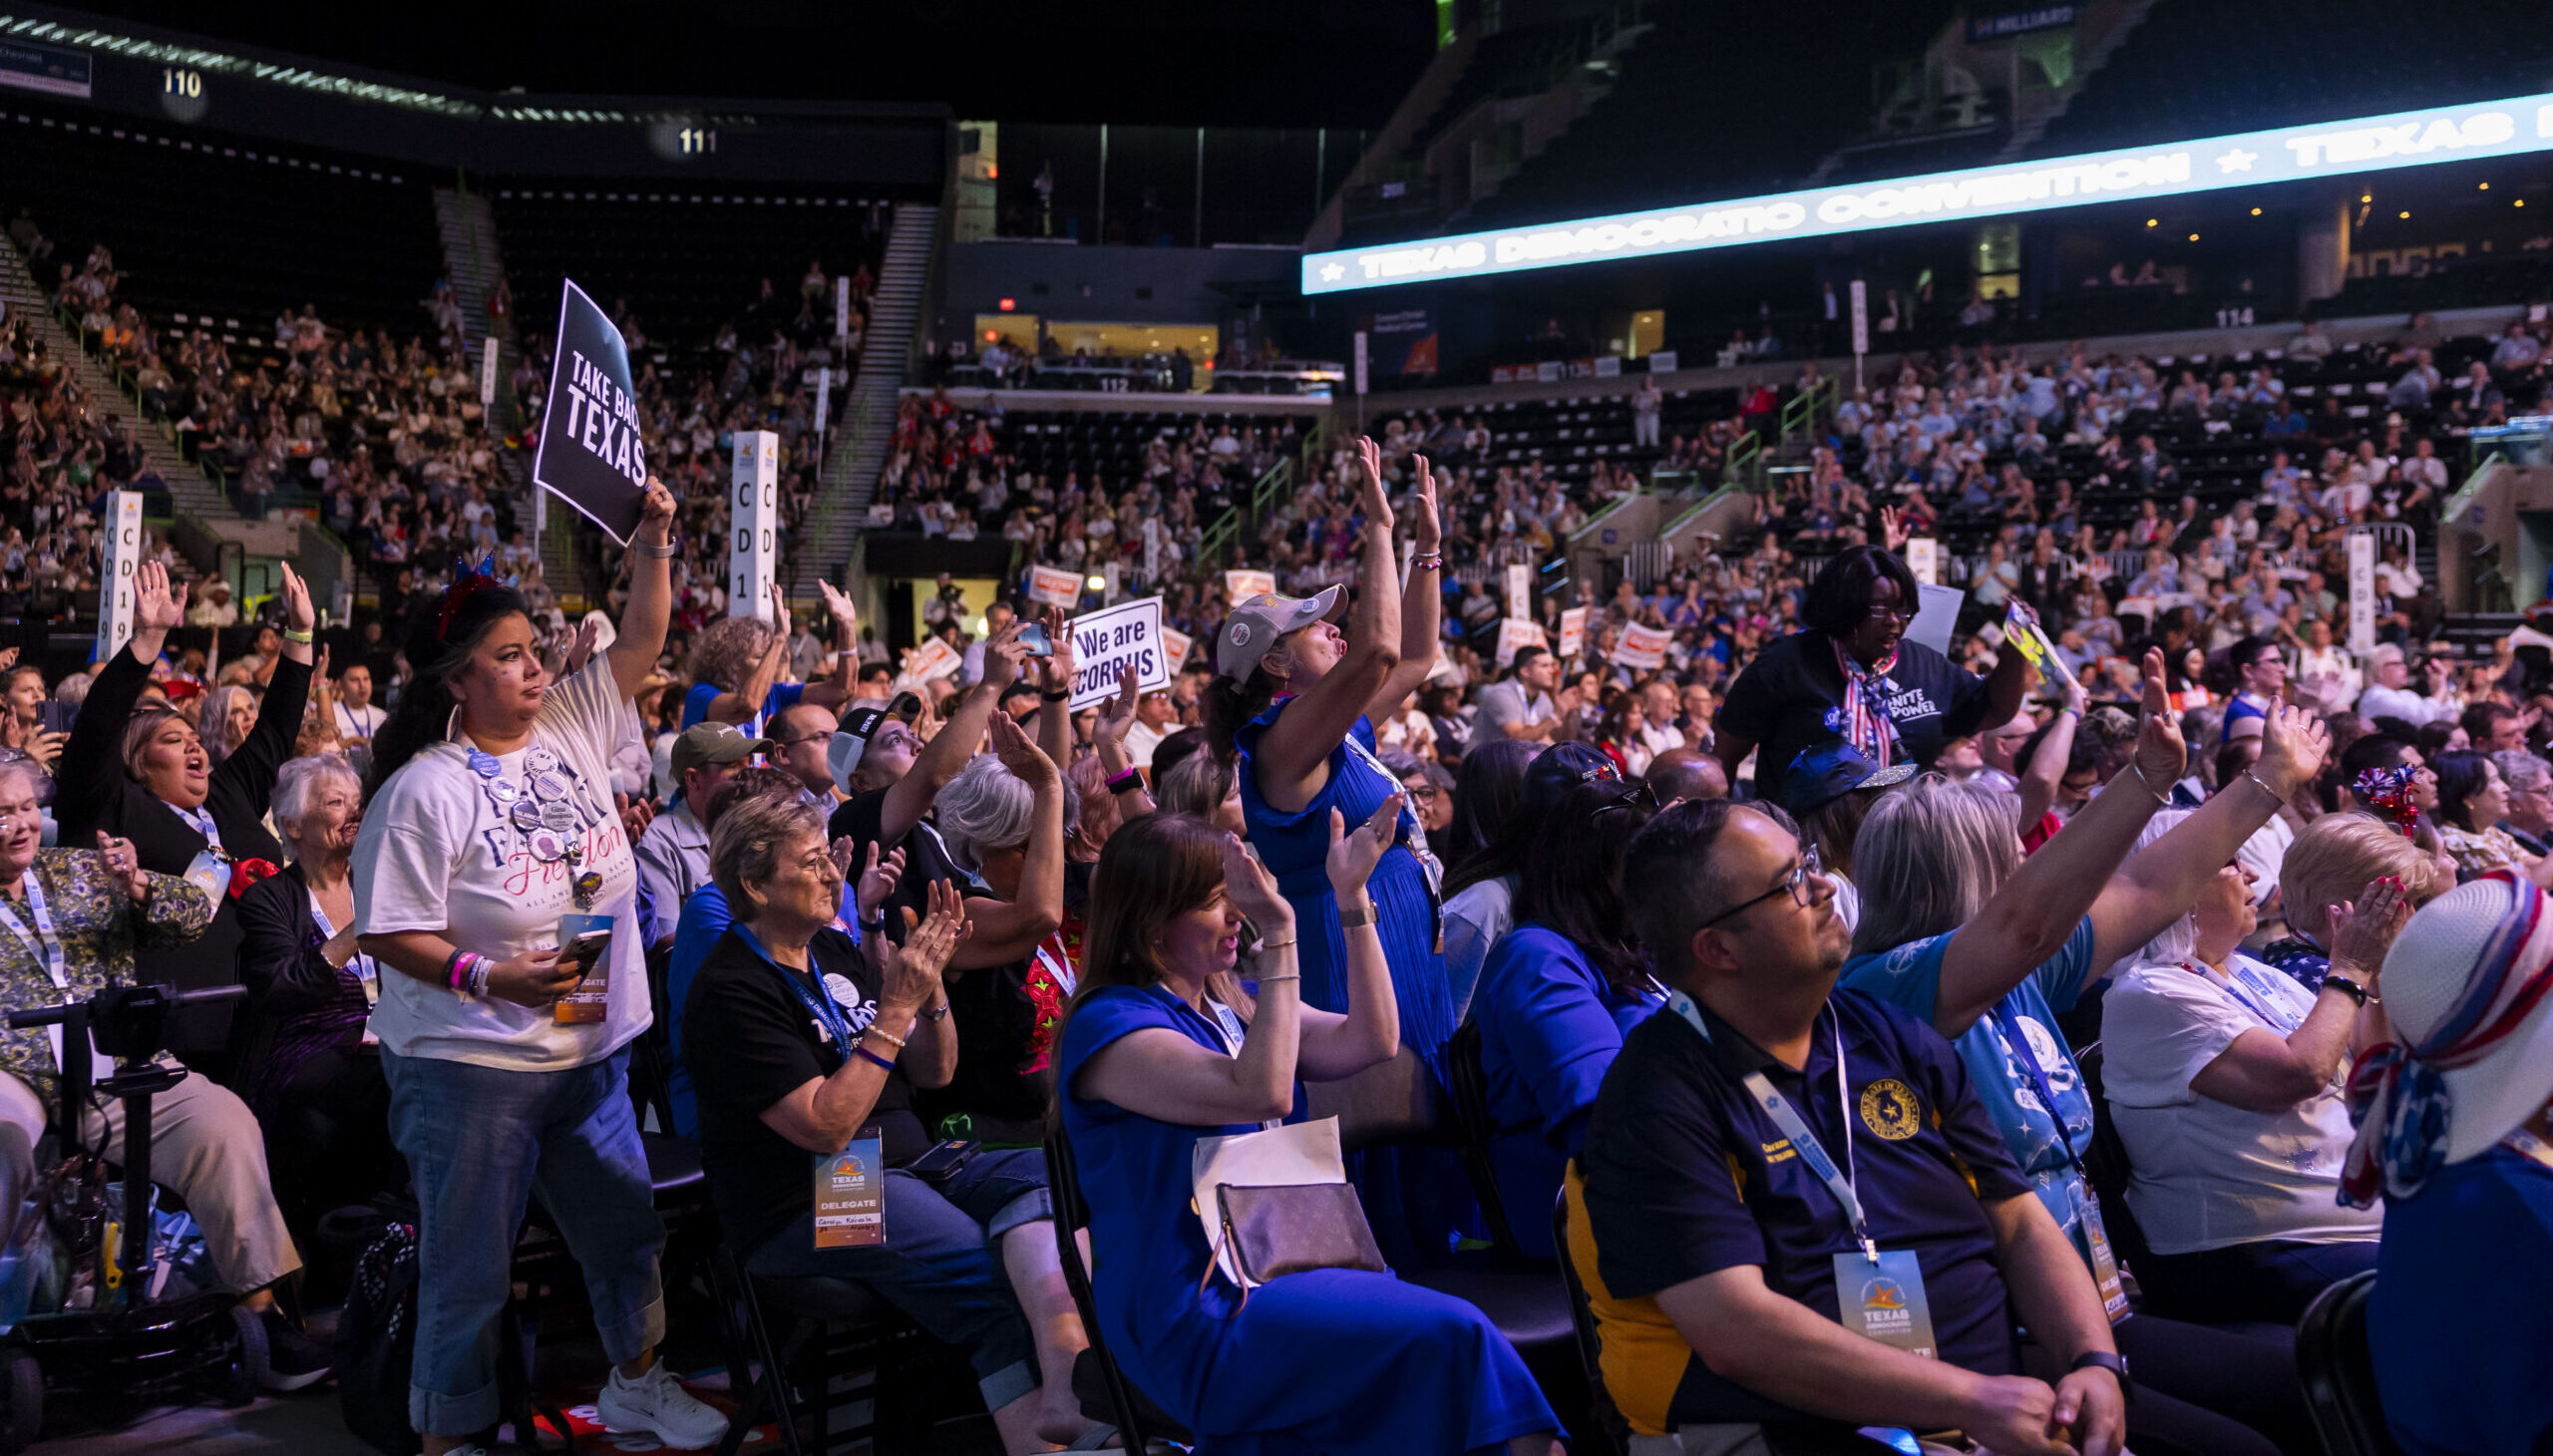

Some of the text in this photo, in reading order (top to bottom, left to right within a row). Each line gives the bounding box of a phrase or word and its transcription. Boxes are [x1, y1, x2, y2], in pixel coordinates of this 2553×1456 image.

[163, 67, 200, 99] 110
[679, 128, 716, 154] 111
[2286, 112, 2513, 167] TEXAS
[1358, 240, 1486, 279] TEXAS
[1817, 153, 2190, 226] CONVENTION
[2215, 305, 2254, 327] 114
[572, 350, 641, 437] TAKE BAC
[1099, 377, 1129, 394] 112
[566, 384, 647, 487] TEXAS
[1075, 629, 1109, 658] We
[1114, 619, 1145, 647] are
[1891, 700, 1937, 718] POWER
[832, 1175, 865, 1184] TEXAS
[822, 1199, 877, 1210] DELEGATE
[1864, 1308, 1910, 1322] TEXAS
